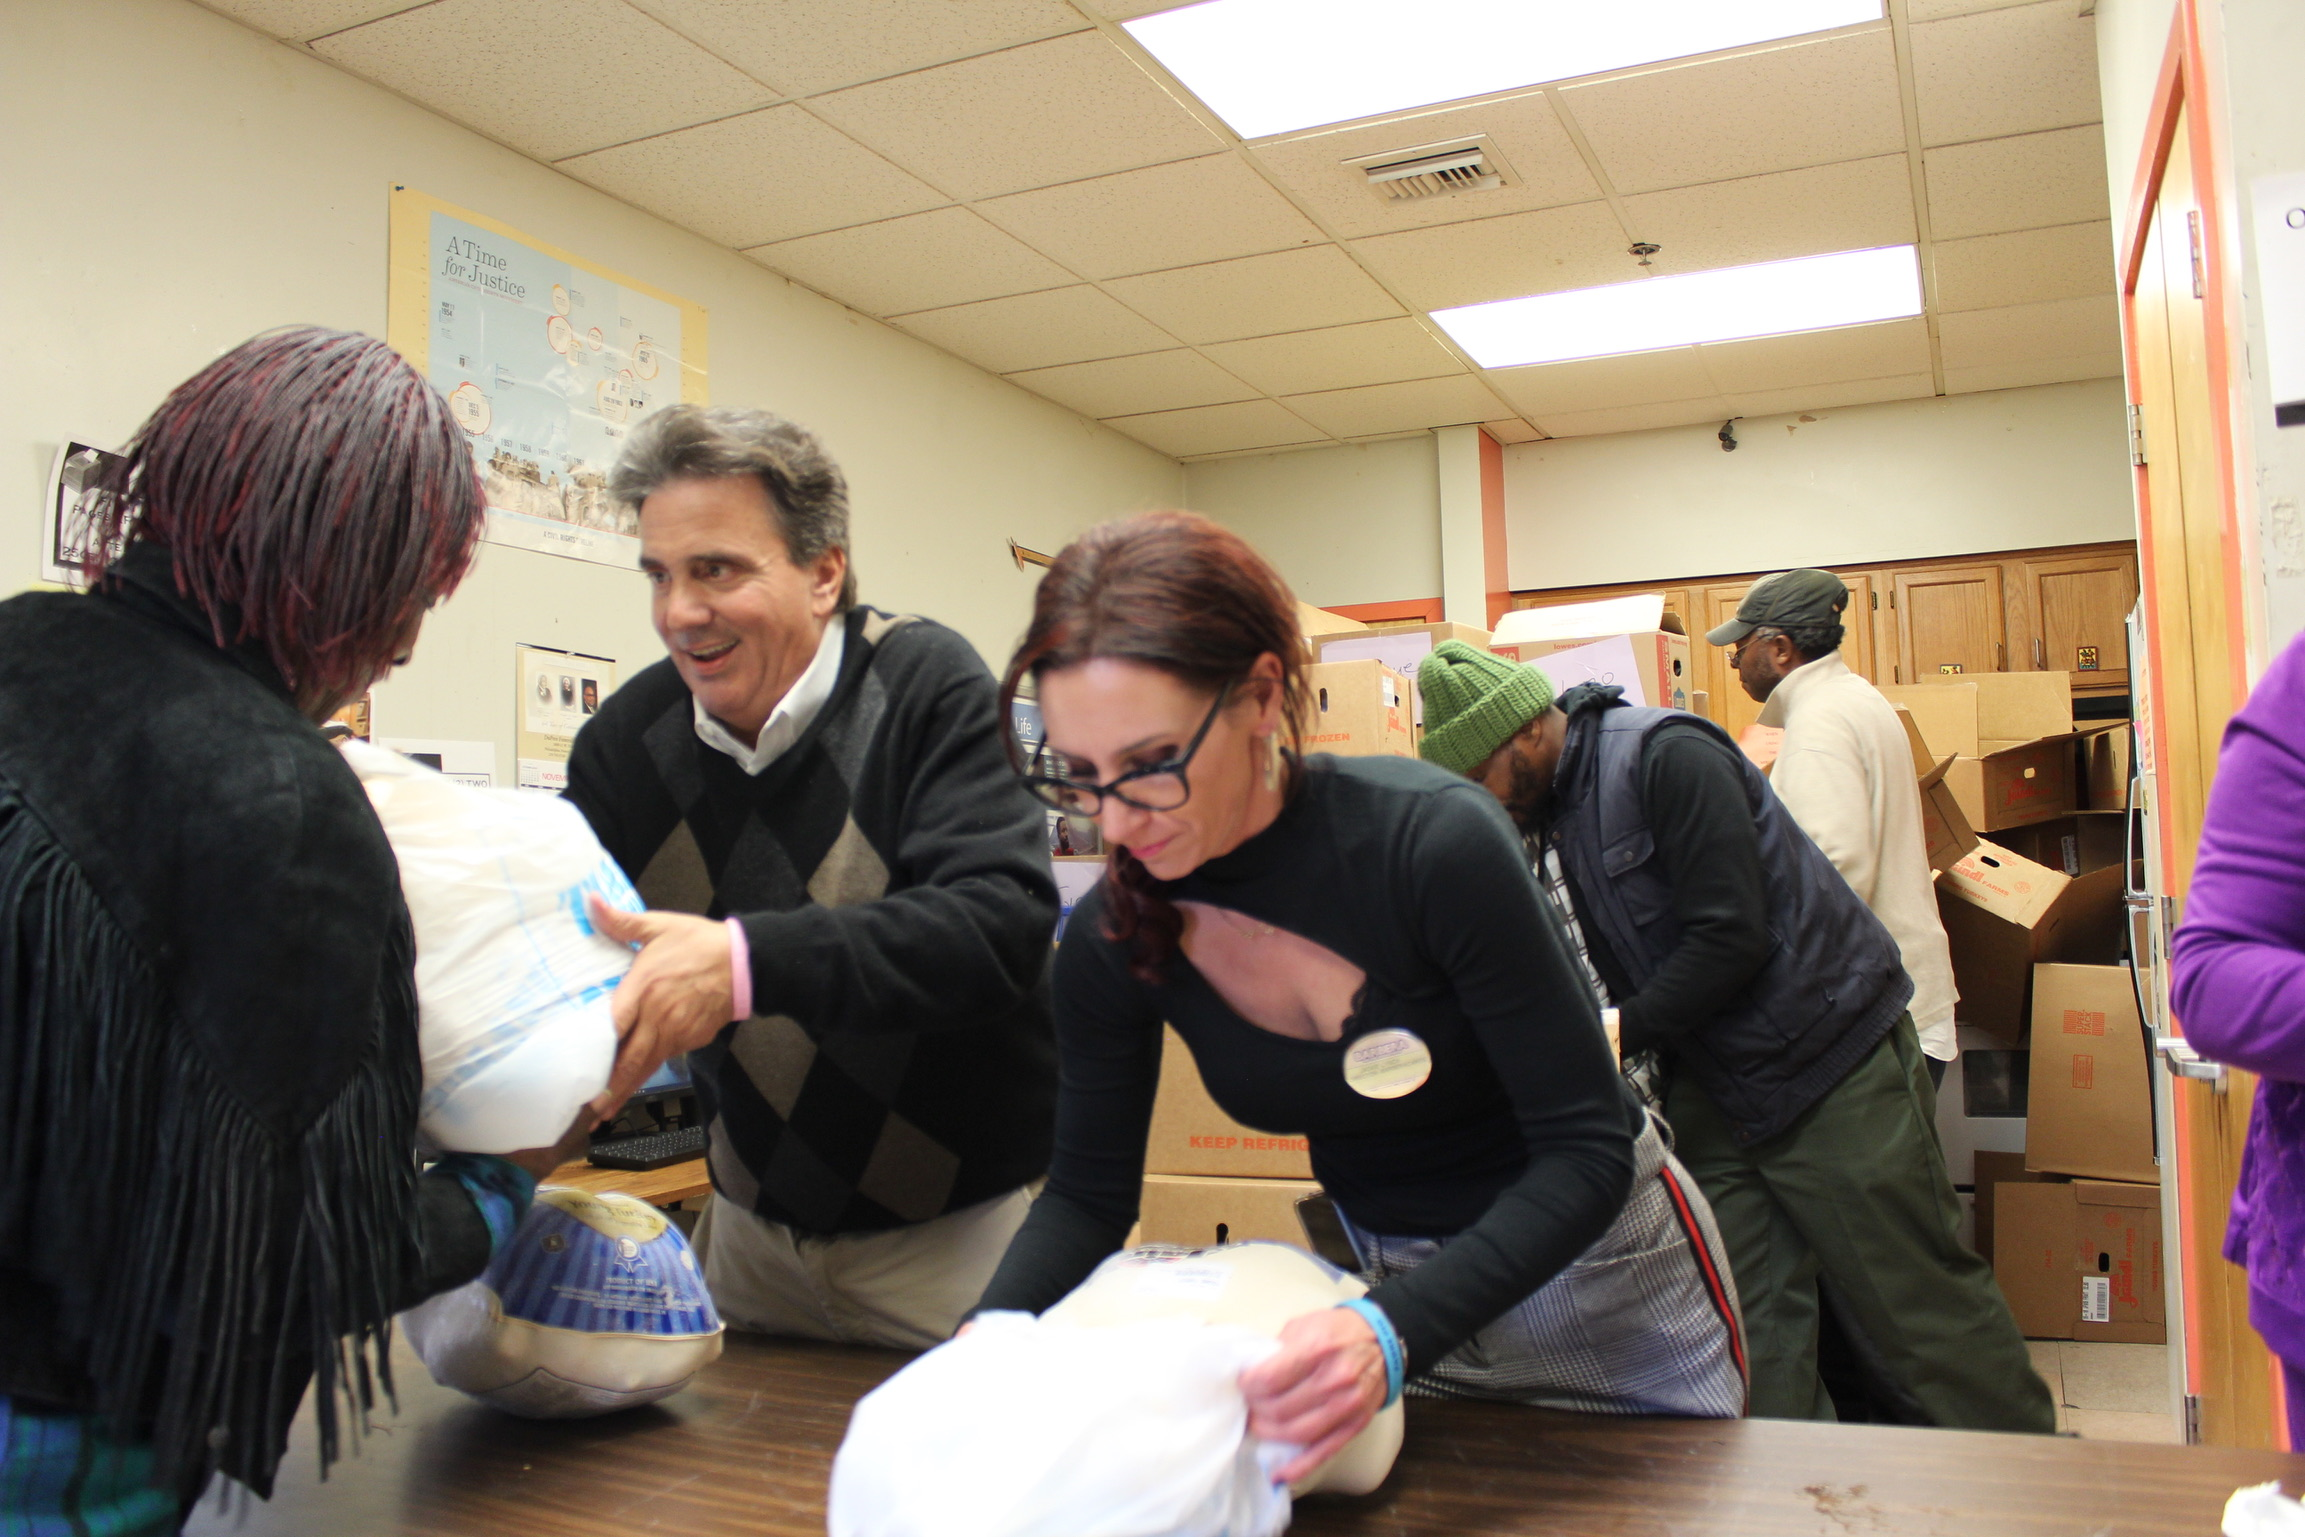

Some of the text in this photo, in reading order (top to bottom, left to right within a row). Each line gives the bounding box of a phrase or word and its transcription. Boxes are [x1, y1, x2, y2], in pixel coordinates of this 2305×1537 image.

[446, 236, 507, 271] A Time
[441, 256, 466, 276] for
[468, 264, 526, 298] Justice
[1015, 717, 1032, 736] Life
[1304, 733, 1350, 743] FROZEN
[466, 780, 488, 788] TWO
[1951, 864, 2010, 896] indl FARMS
[2084, 1012, 2092, 1036] STACK
[1189, 1136, 1238, 1149] KEEP
[605, 1277, 634, 1285] PRODUCT
